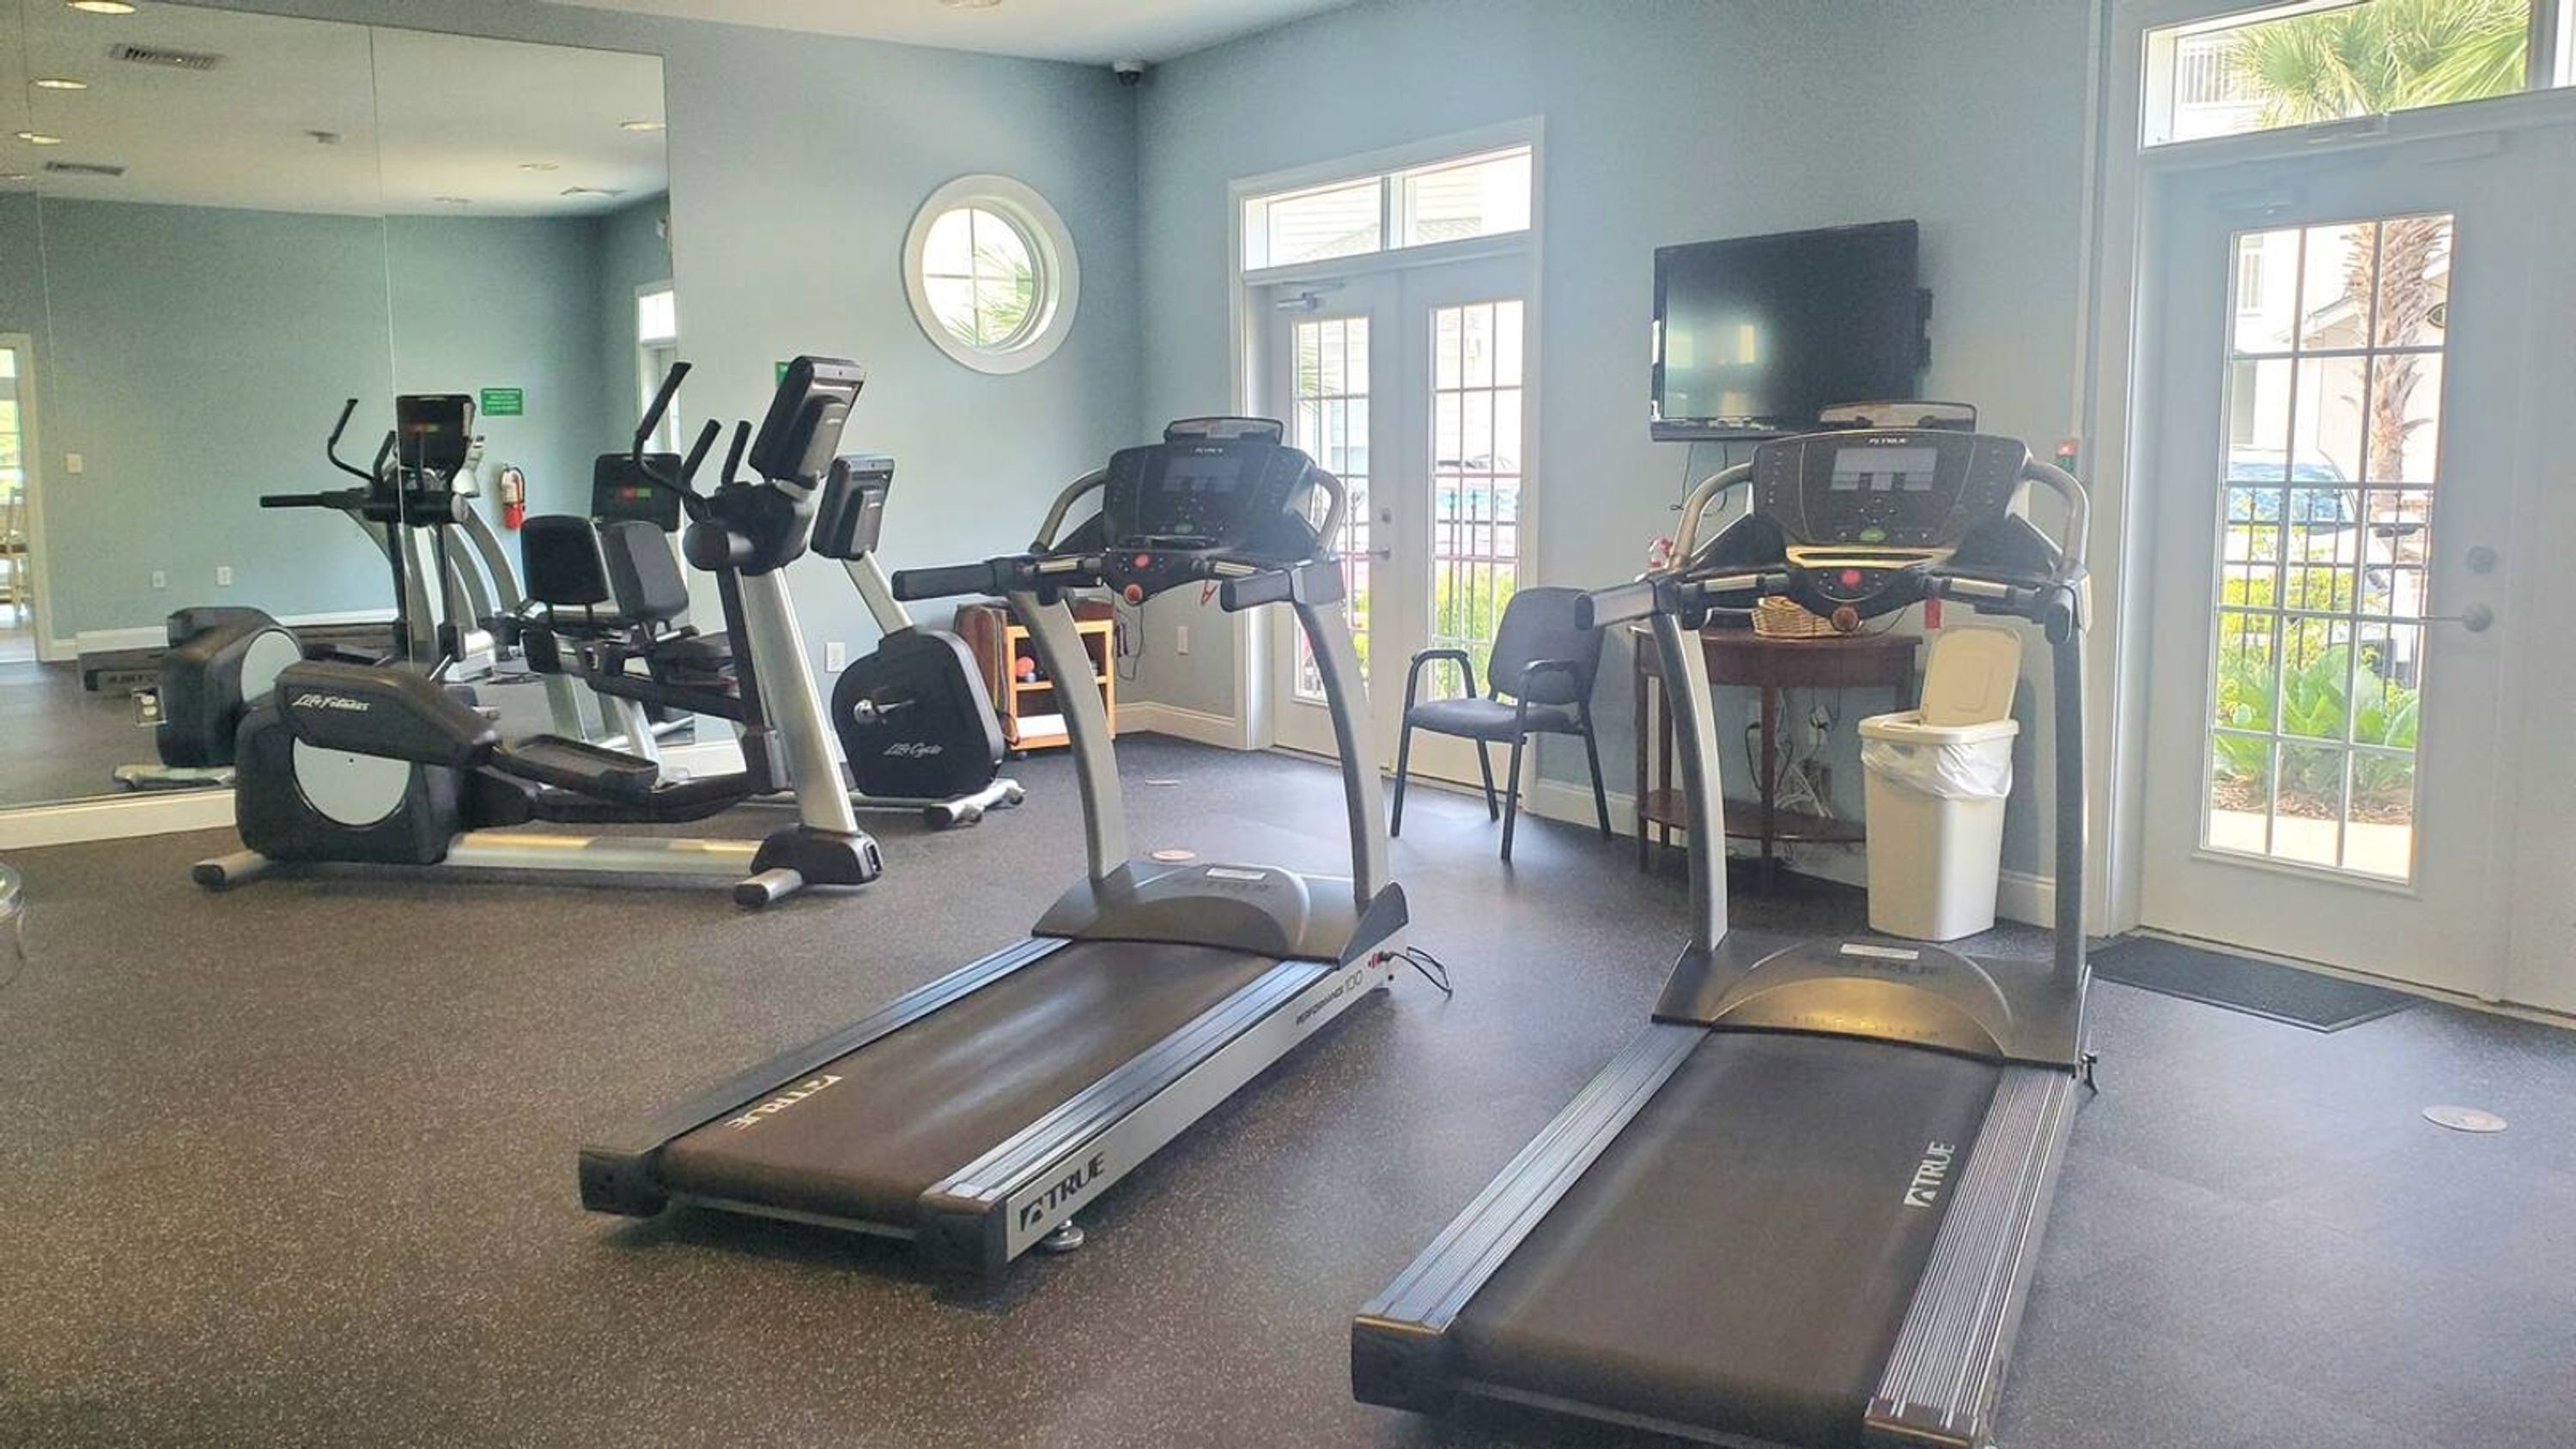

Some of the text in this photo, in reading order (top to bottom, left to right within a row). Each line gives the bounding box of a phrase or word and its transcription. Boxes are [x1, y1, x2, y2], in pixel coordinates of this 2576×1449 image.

[723, 1090, 815, 1131] TRUE
[1044, 1151, 1104, 1210] TRUE
[1911, 1141, 1955, 1186] TRUE
